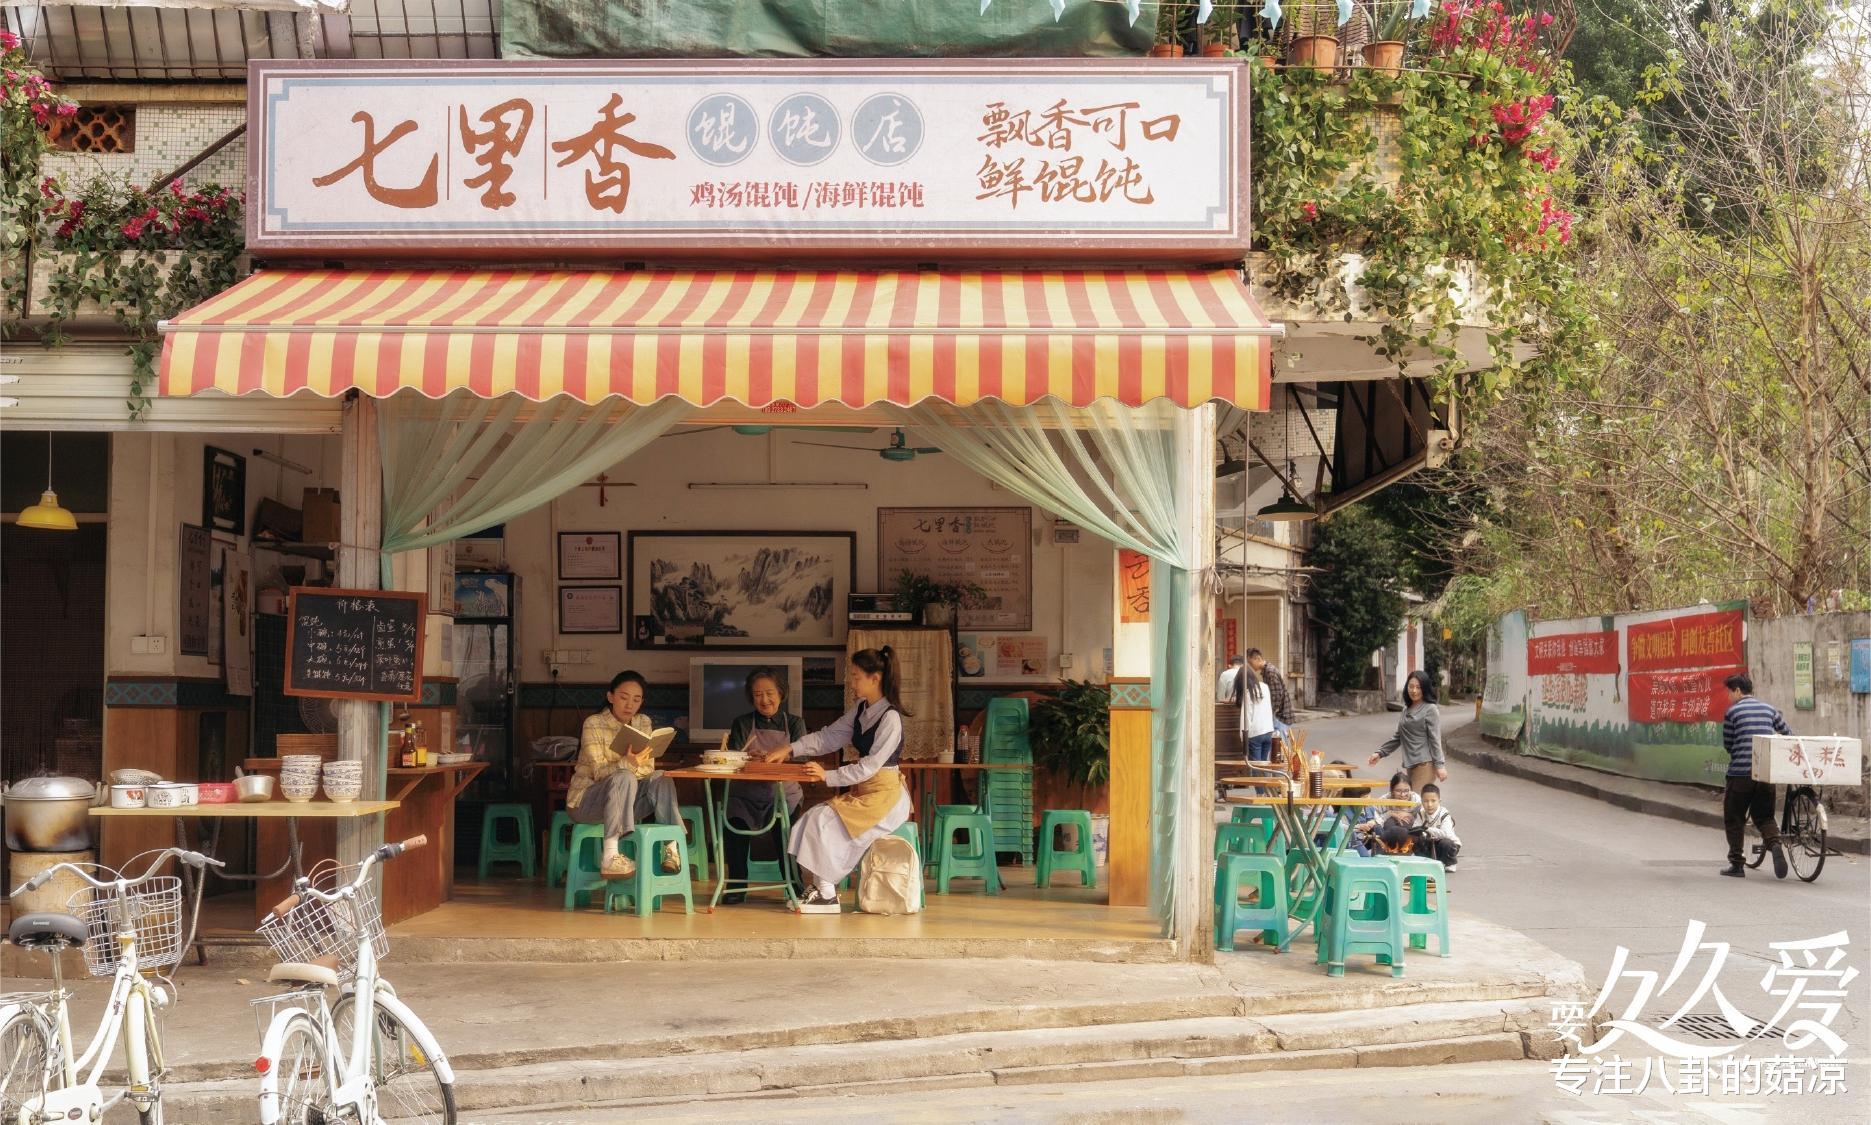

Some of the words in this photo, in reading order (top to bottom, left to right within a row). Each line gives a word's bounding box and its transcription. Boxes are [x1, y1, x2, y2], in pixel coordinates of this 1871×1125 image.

[695, 98, 908, 155] 馄饨店
[976, 98, 1182, 151] 飘香可口
[312, 92, 677, 214] 七里香
[975, 152, 1156, 209] 鲜馄饨
[689, 181, 925, 211] 鸡汤馄饨/海鲜馄饨
[913, 516, 965, 533] 七里香
